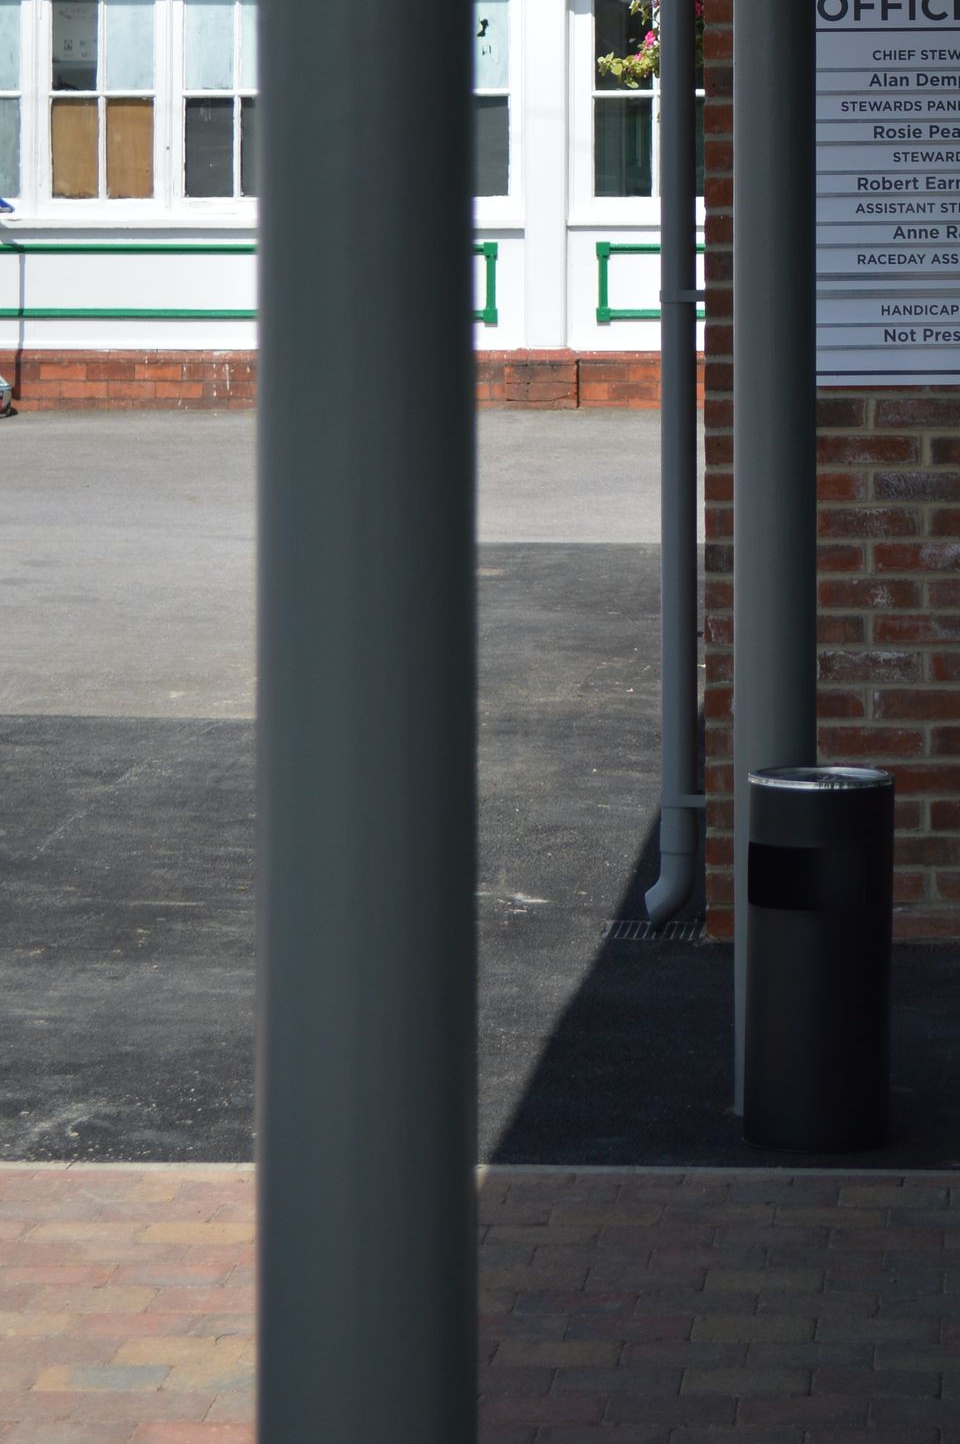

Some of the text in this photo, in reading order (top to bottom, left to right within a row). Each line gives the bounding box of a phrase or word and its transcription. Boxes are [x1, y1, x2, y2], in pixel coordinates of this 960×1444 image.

[872, 49, 916, 61] CHIEF
[869, 73, 909, 87] Alan
[841, 100, 923, 112] STEWARDS
[873, 125, 923, 139] Rosie
[857, 176, 919, 191] Robert
[855, 202, 936, 214] ASSISTANT
[893, 225, 939, 240] Anne
[857, 253, 926, 265] RACEDAY
[884, 328, 916, 343] Not
